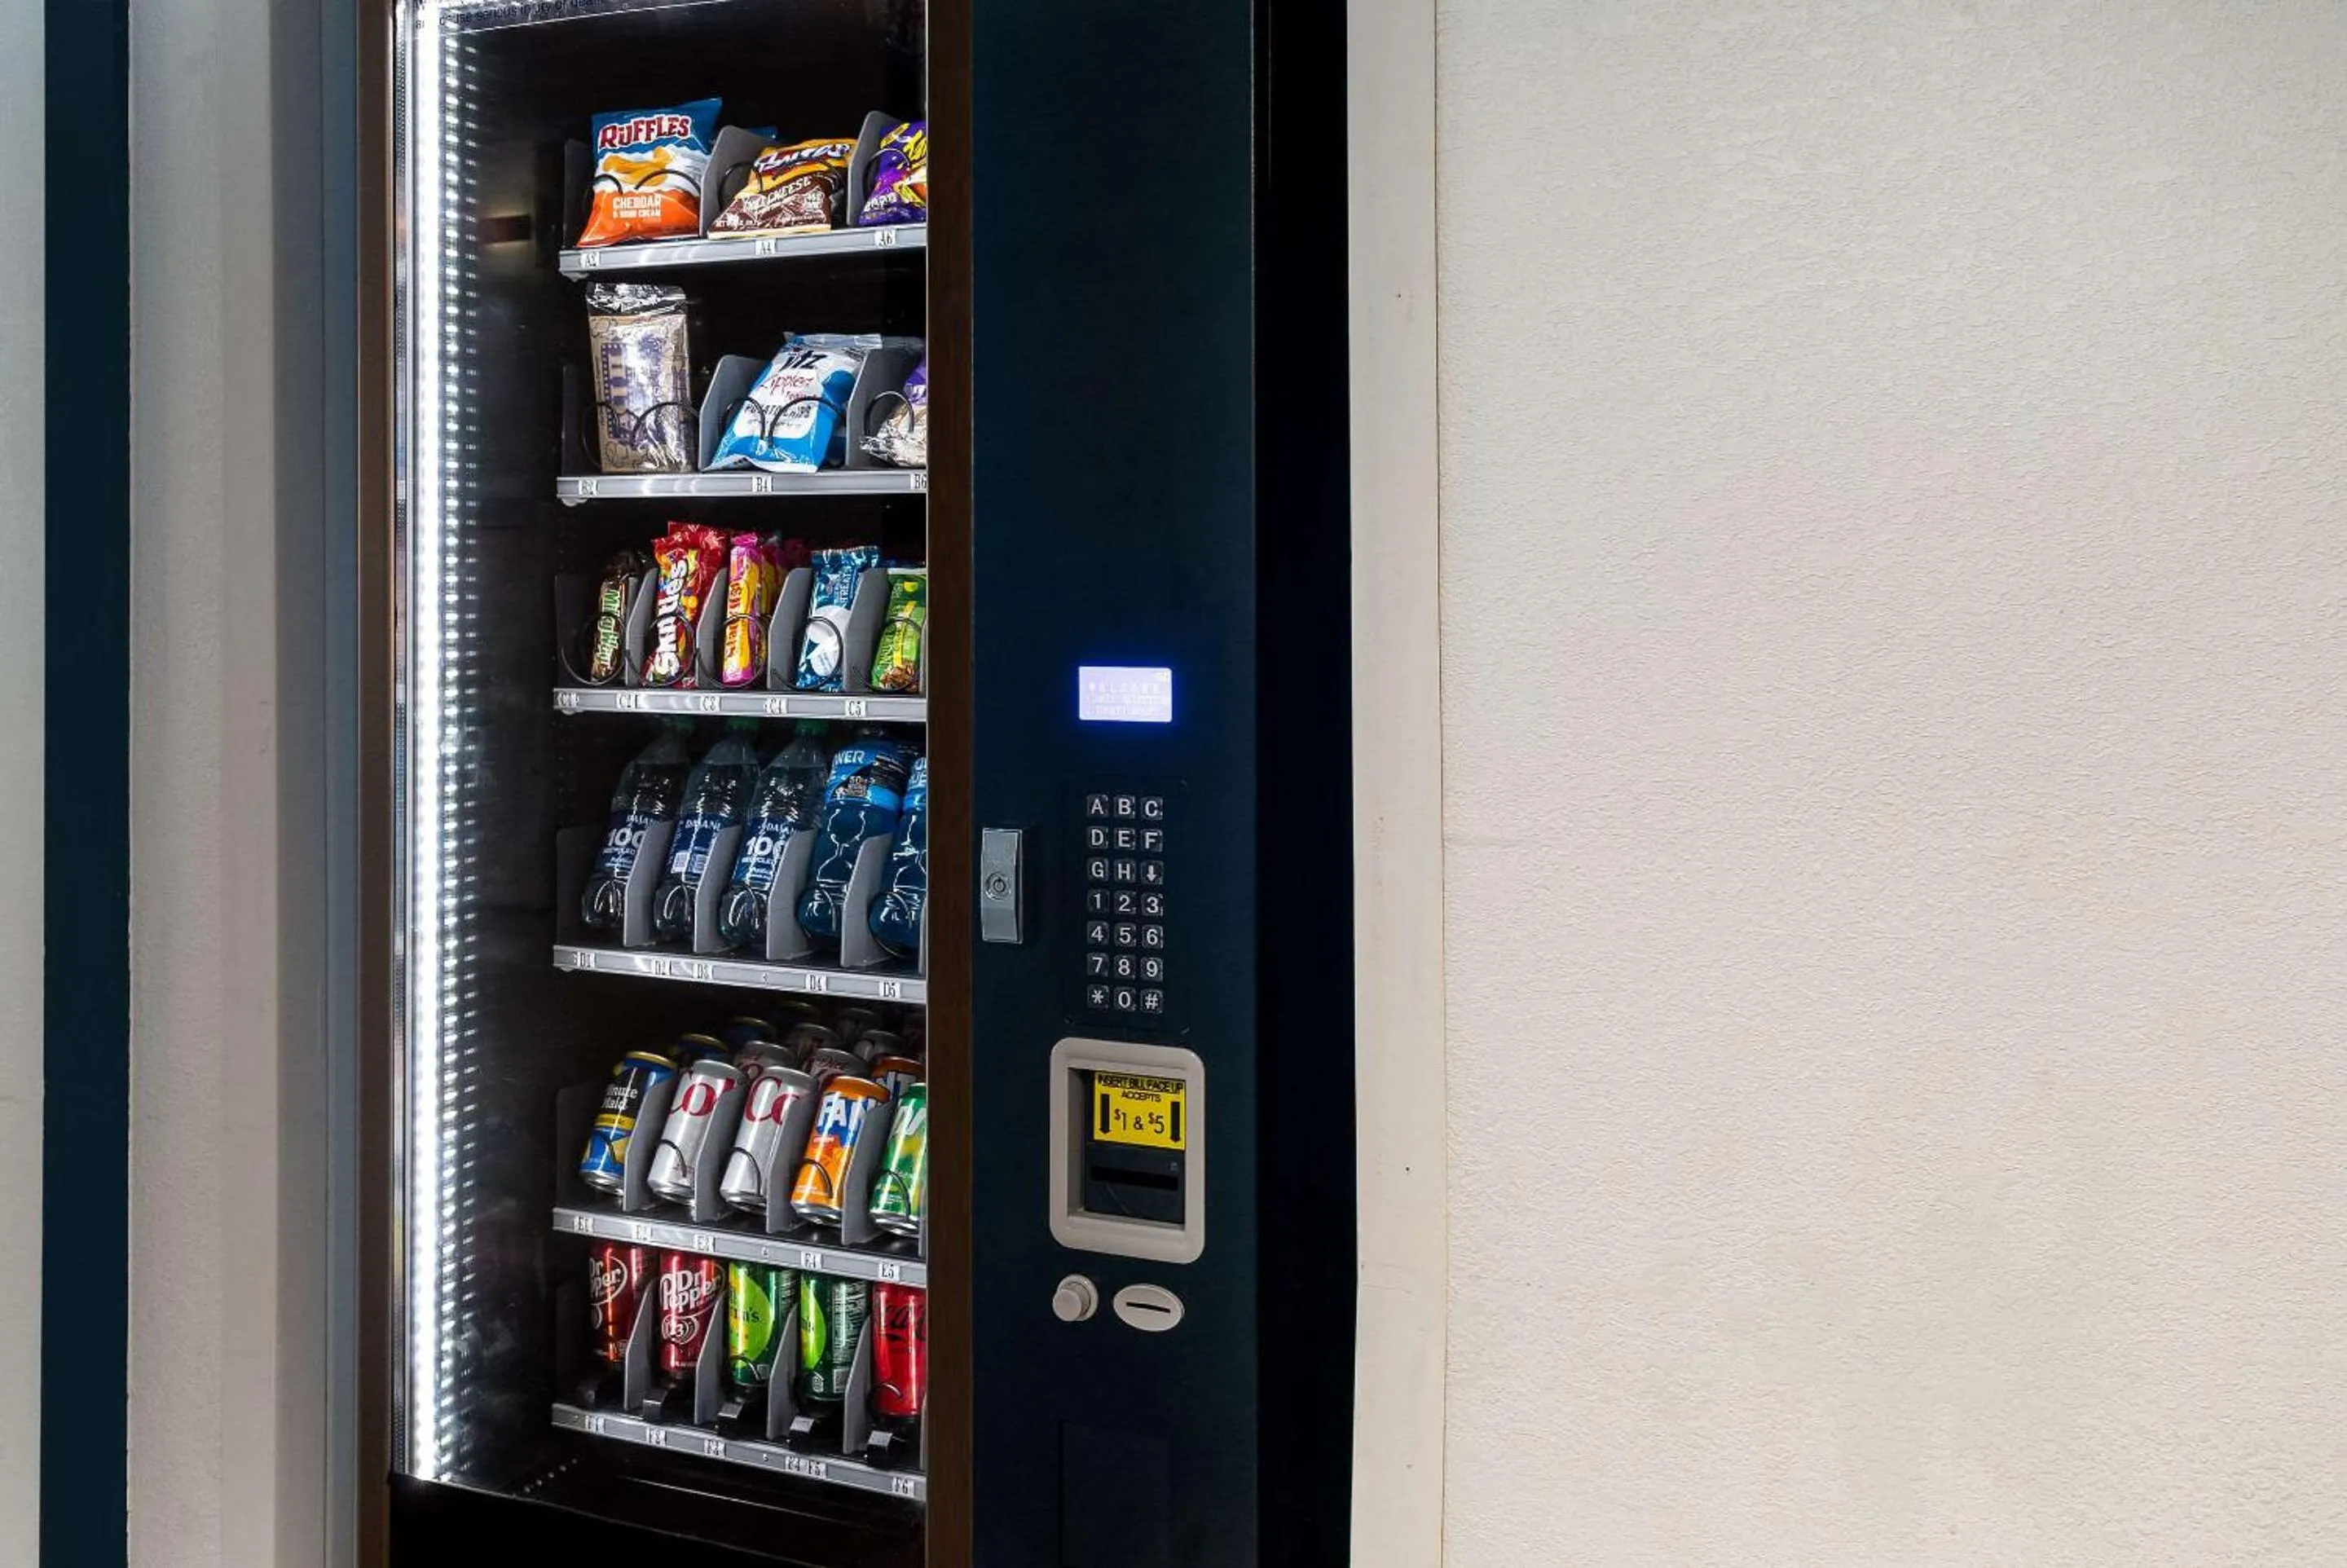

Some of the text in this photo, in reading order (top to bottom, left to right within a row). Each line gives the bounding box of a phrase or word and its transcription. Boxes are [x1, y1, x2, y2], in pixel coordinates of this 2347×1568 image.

[599, 115, 691, 149] RUFFLES
[613, 193, 661, 209] CHEDDAR
[1091, 798, 1158, 817] A B C
[1091, 829, 1158, 849] D E F
[1091, 861, 1130, 880] G H
[1093, 892, 1158, 914] 1 2 3
[1091, 926, 1158, 945] 4 5 6
[1092, 957, 1158, 977] 7 8 9
[1118, 991, 1158, 1010] 0 #
[1121, 1090, 1161, 1102] ACCEPTS
[817, 1092, 878, 1131] FAN
[1114, 1108, 1165, 1134] $1 & $5
